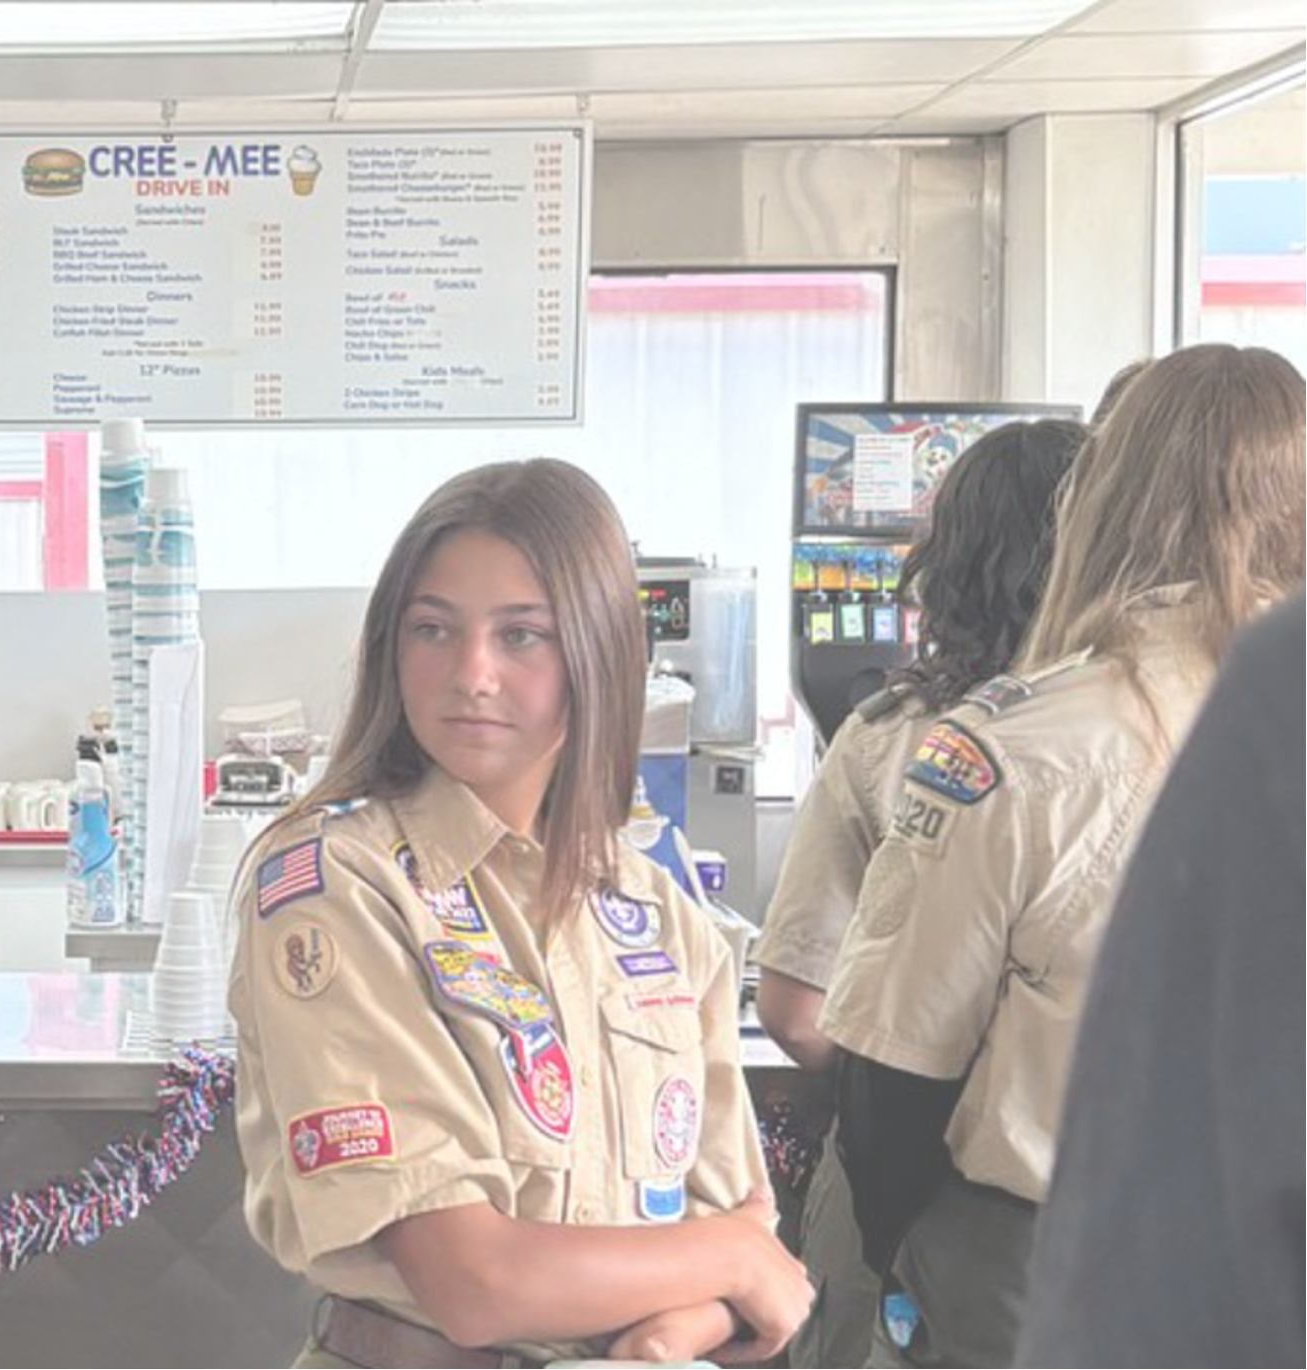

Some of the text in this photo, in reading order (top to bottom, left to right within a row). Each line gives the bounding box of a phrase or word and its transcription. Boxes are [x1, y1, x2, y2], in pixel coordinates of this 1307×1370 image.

[89, 145, 176, 176] CREE
[204, 145, 281, 176] MEE
[137, 180, 229, 196] DRIVE IN
[135, 205, 206, 215] Sandwiches
[439, 236, 478, 247] Salads
[434, 279, 477, 290] Snacks
[147, 291, 193, 302] Dinners
[140, 364, 201, 375] 12" Pizzas
[422, 366, 484, 376] Kids Meals
[339, 1138, 379, 1157] 2020
